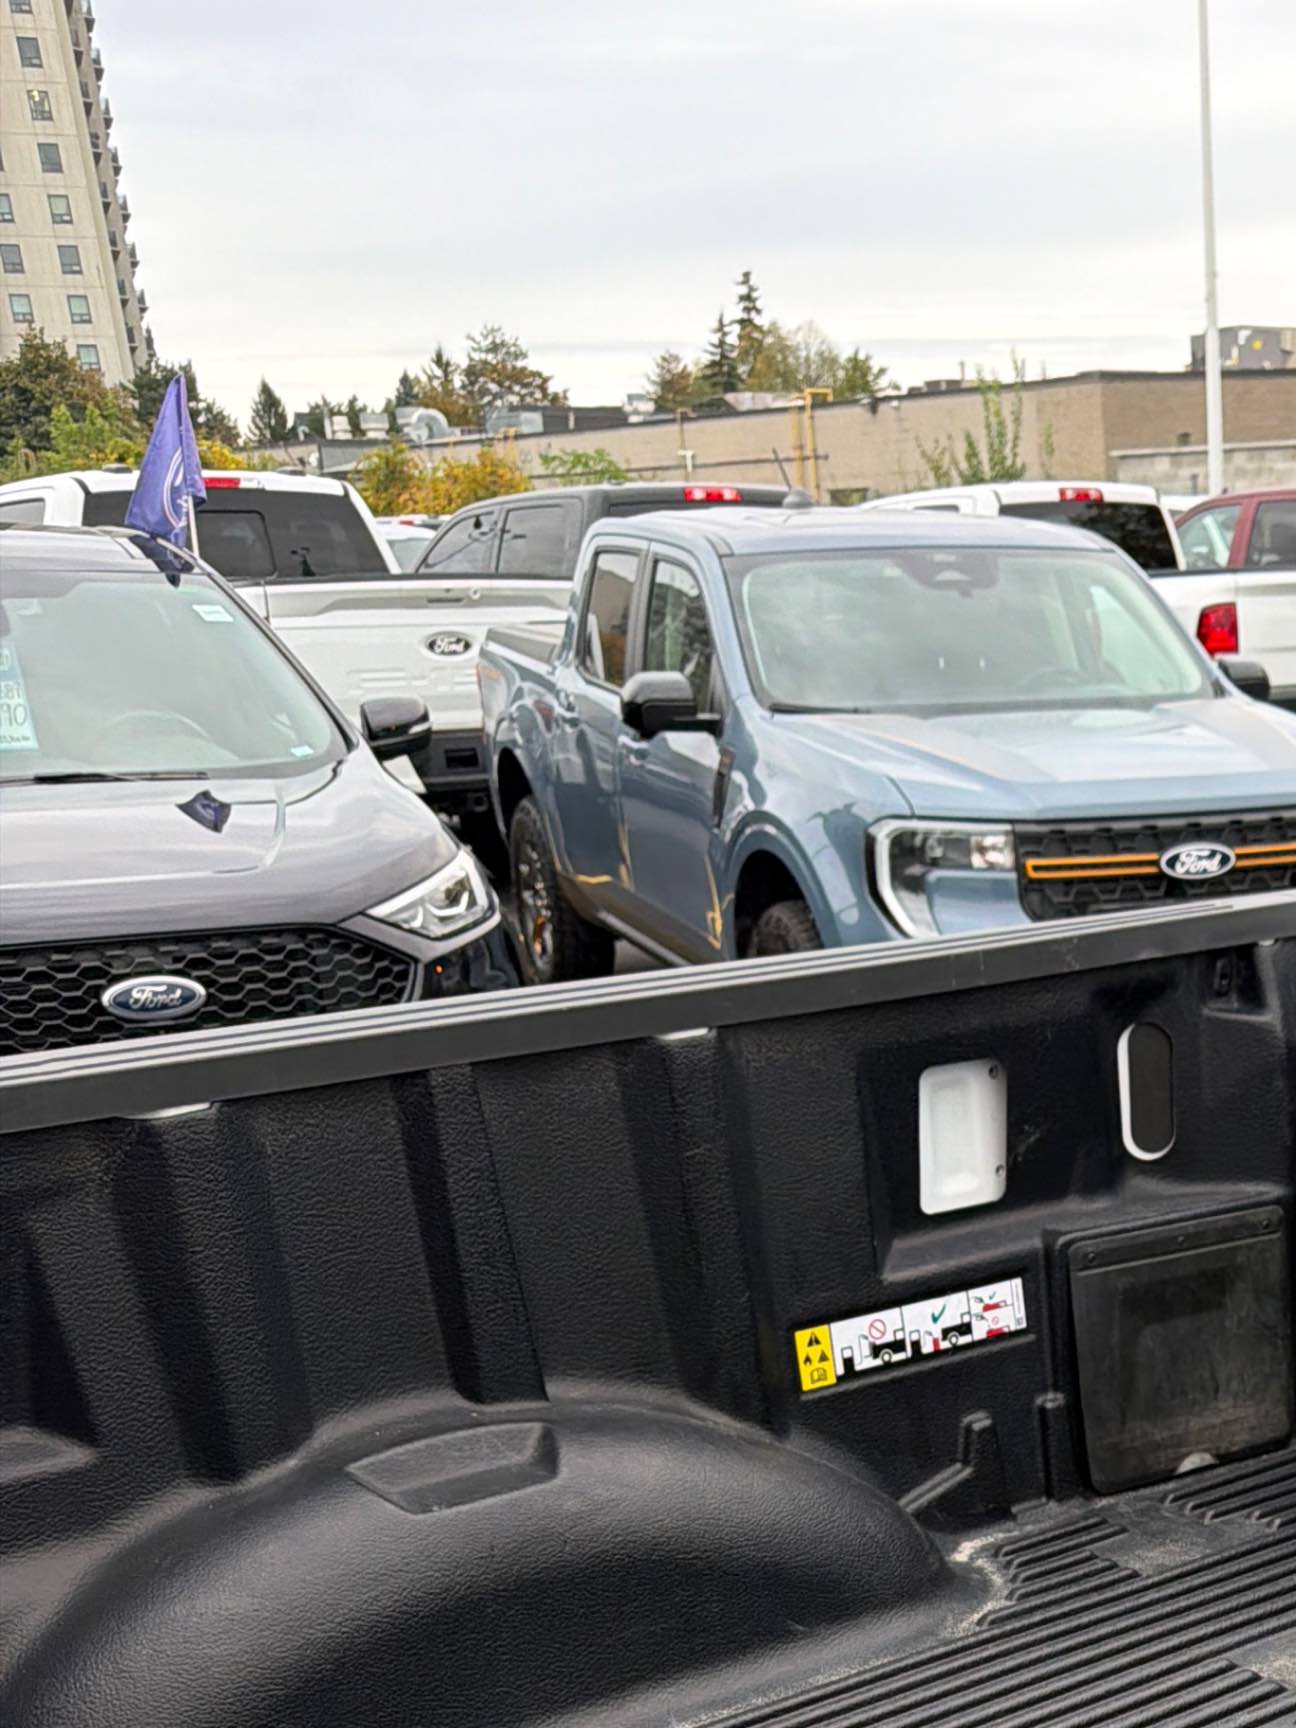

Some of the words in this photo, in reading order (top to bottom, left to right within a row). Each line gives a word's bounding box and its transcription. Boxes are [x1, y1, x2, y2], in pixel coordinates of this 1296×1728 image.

[434, 635, 465, 653] Ford
[1175, 849, 1222, 874] Ford
[128, 984, 183, 1010] Ford
